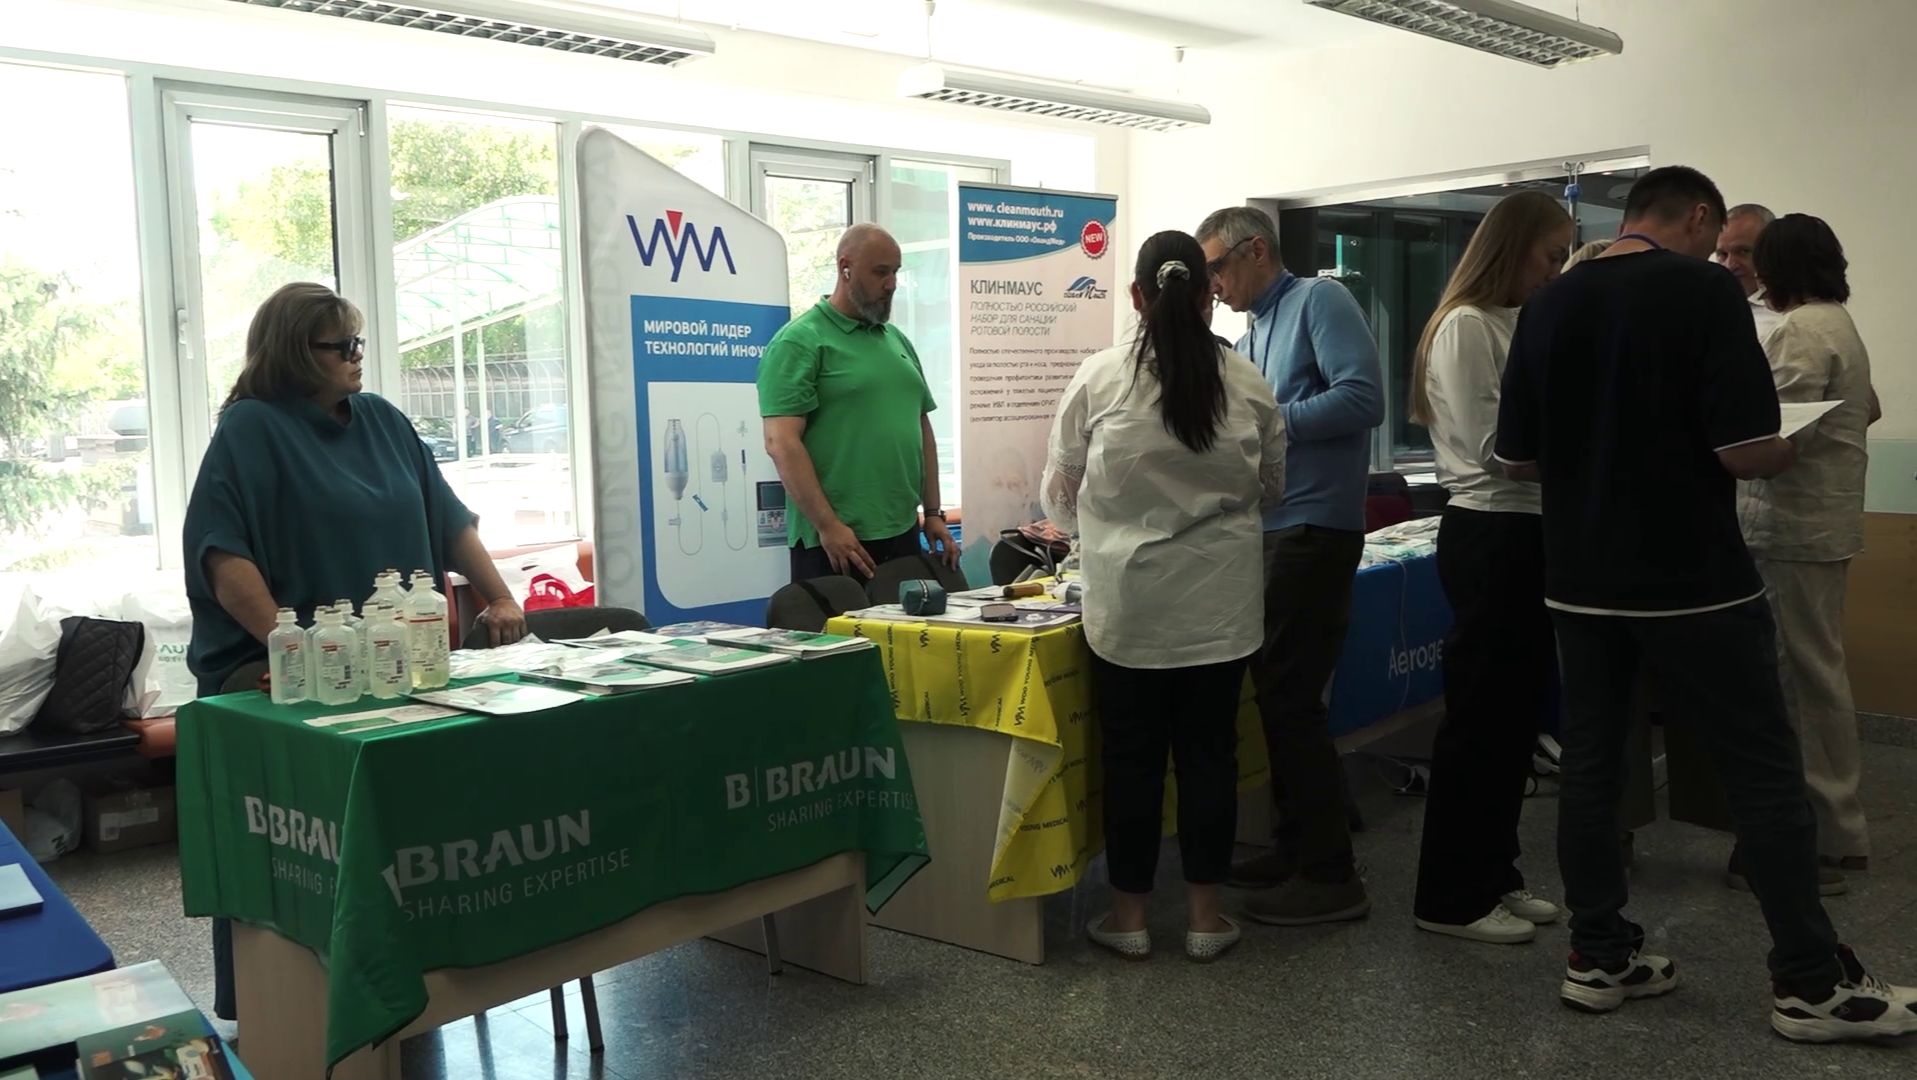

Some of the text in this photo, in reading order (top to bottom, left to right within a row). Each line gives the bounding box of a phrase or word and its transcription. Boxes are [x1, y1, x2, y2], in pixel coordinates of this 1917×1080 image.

[996, 202, 1064, 218] cleanmouth.ru
[1015, 236, 1029, 244] ООО
[1085, 232, 1103, 244] NEW
[970, 280, 1043, 296] КЛИНМАУС
[970, 301, 1077, 313] ПОЛНОСТЬЮ РОССИЙСКИЙ
[970, 314, 1058, 325] НАБОР ДЛЯ САНАЦИИ
[644, 318, 752, 340] МИРОВОЙ ЛИДЕР
[970, 325, 1051, 337] РОТОВОЙ ПОЛОСТИ
[644, 340, 729, 357] ТЕХНОЛОГИЙ
[765, 746, 896, 803] BRAUN
[767, 797, 833, 832] SHARING
[394, 809, 592, 889] BRAUN
[271, 857, 323, 895] SHARING
[402, 880, 514, 924] SHARING
[523, 847, 632, 898] EXPERTISE
